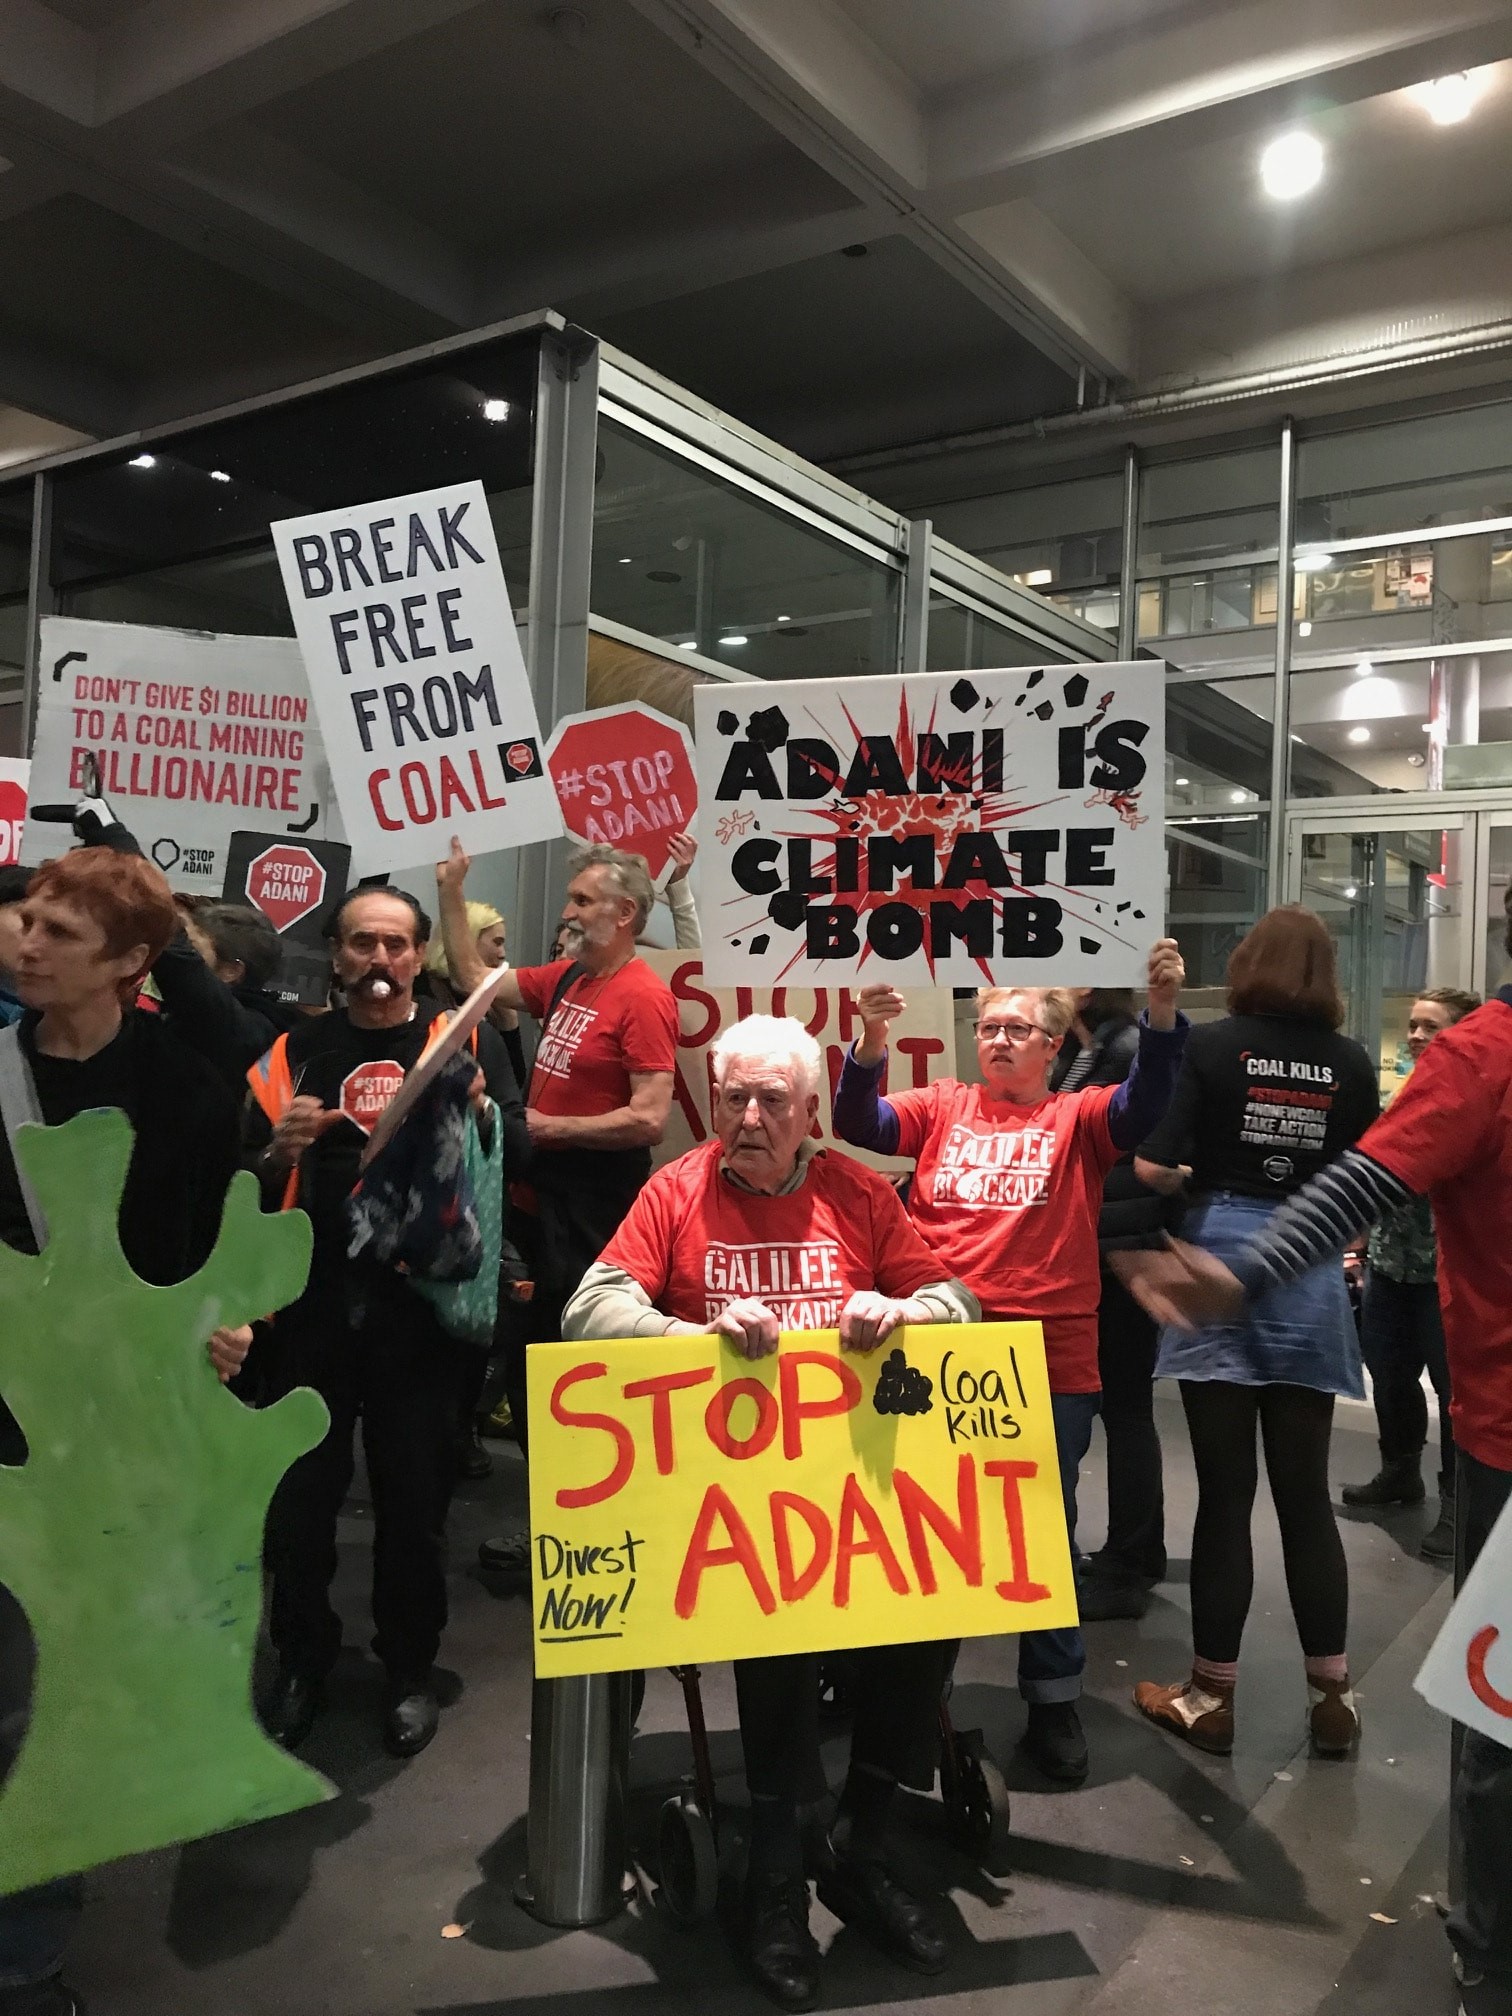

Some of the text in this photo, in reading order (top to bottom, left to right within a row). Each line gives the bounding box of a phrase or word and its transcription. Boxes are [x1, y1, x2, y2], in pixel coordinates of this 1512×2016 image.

[293, 502, 485, 599] BREAK
[329, 588, 474, 675] FREE
[74, 675, 308, 723] DON'T GIVE $1 BILLION
[351, 664, 503, 752] FROM
[72, 708, 304, 761] TO A COAL MINING
[715, 719, 1151, 801] ADANI IS
[368, 749, 507, 831] COAL
[557, 750, 674, 806] #STOP
[585, 794, 685, 843] ADANI
[182, 862, 213, 875] ADANI
[183, 849, 215, 862] #STOP
[262, 861, 313, 884] #STOP
[731, 827, 1116, 896] CLIMATE
[260, 881, 309, 903] ADANI
[806, 896, 1063, 960] BOMB
[353, 1076, 404, 1094] #STOP
[1246, 1059, 1333, 1083] COAL KILLS
[942, 1131, 1055, 1168] GALILEE
[1243, 1115, 1327, 1138] TAKE ACTION
[704, 1248, 842, 1293] GALILEE
[941, 1346, 1028, 1409] Coal
[549, 1351, 863, 1509] STOP
[536, 1530, 645, 1581] Divest
[674, 1453, 1052, 1621] ADANI
